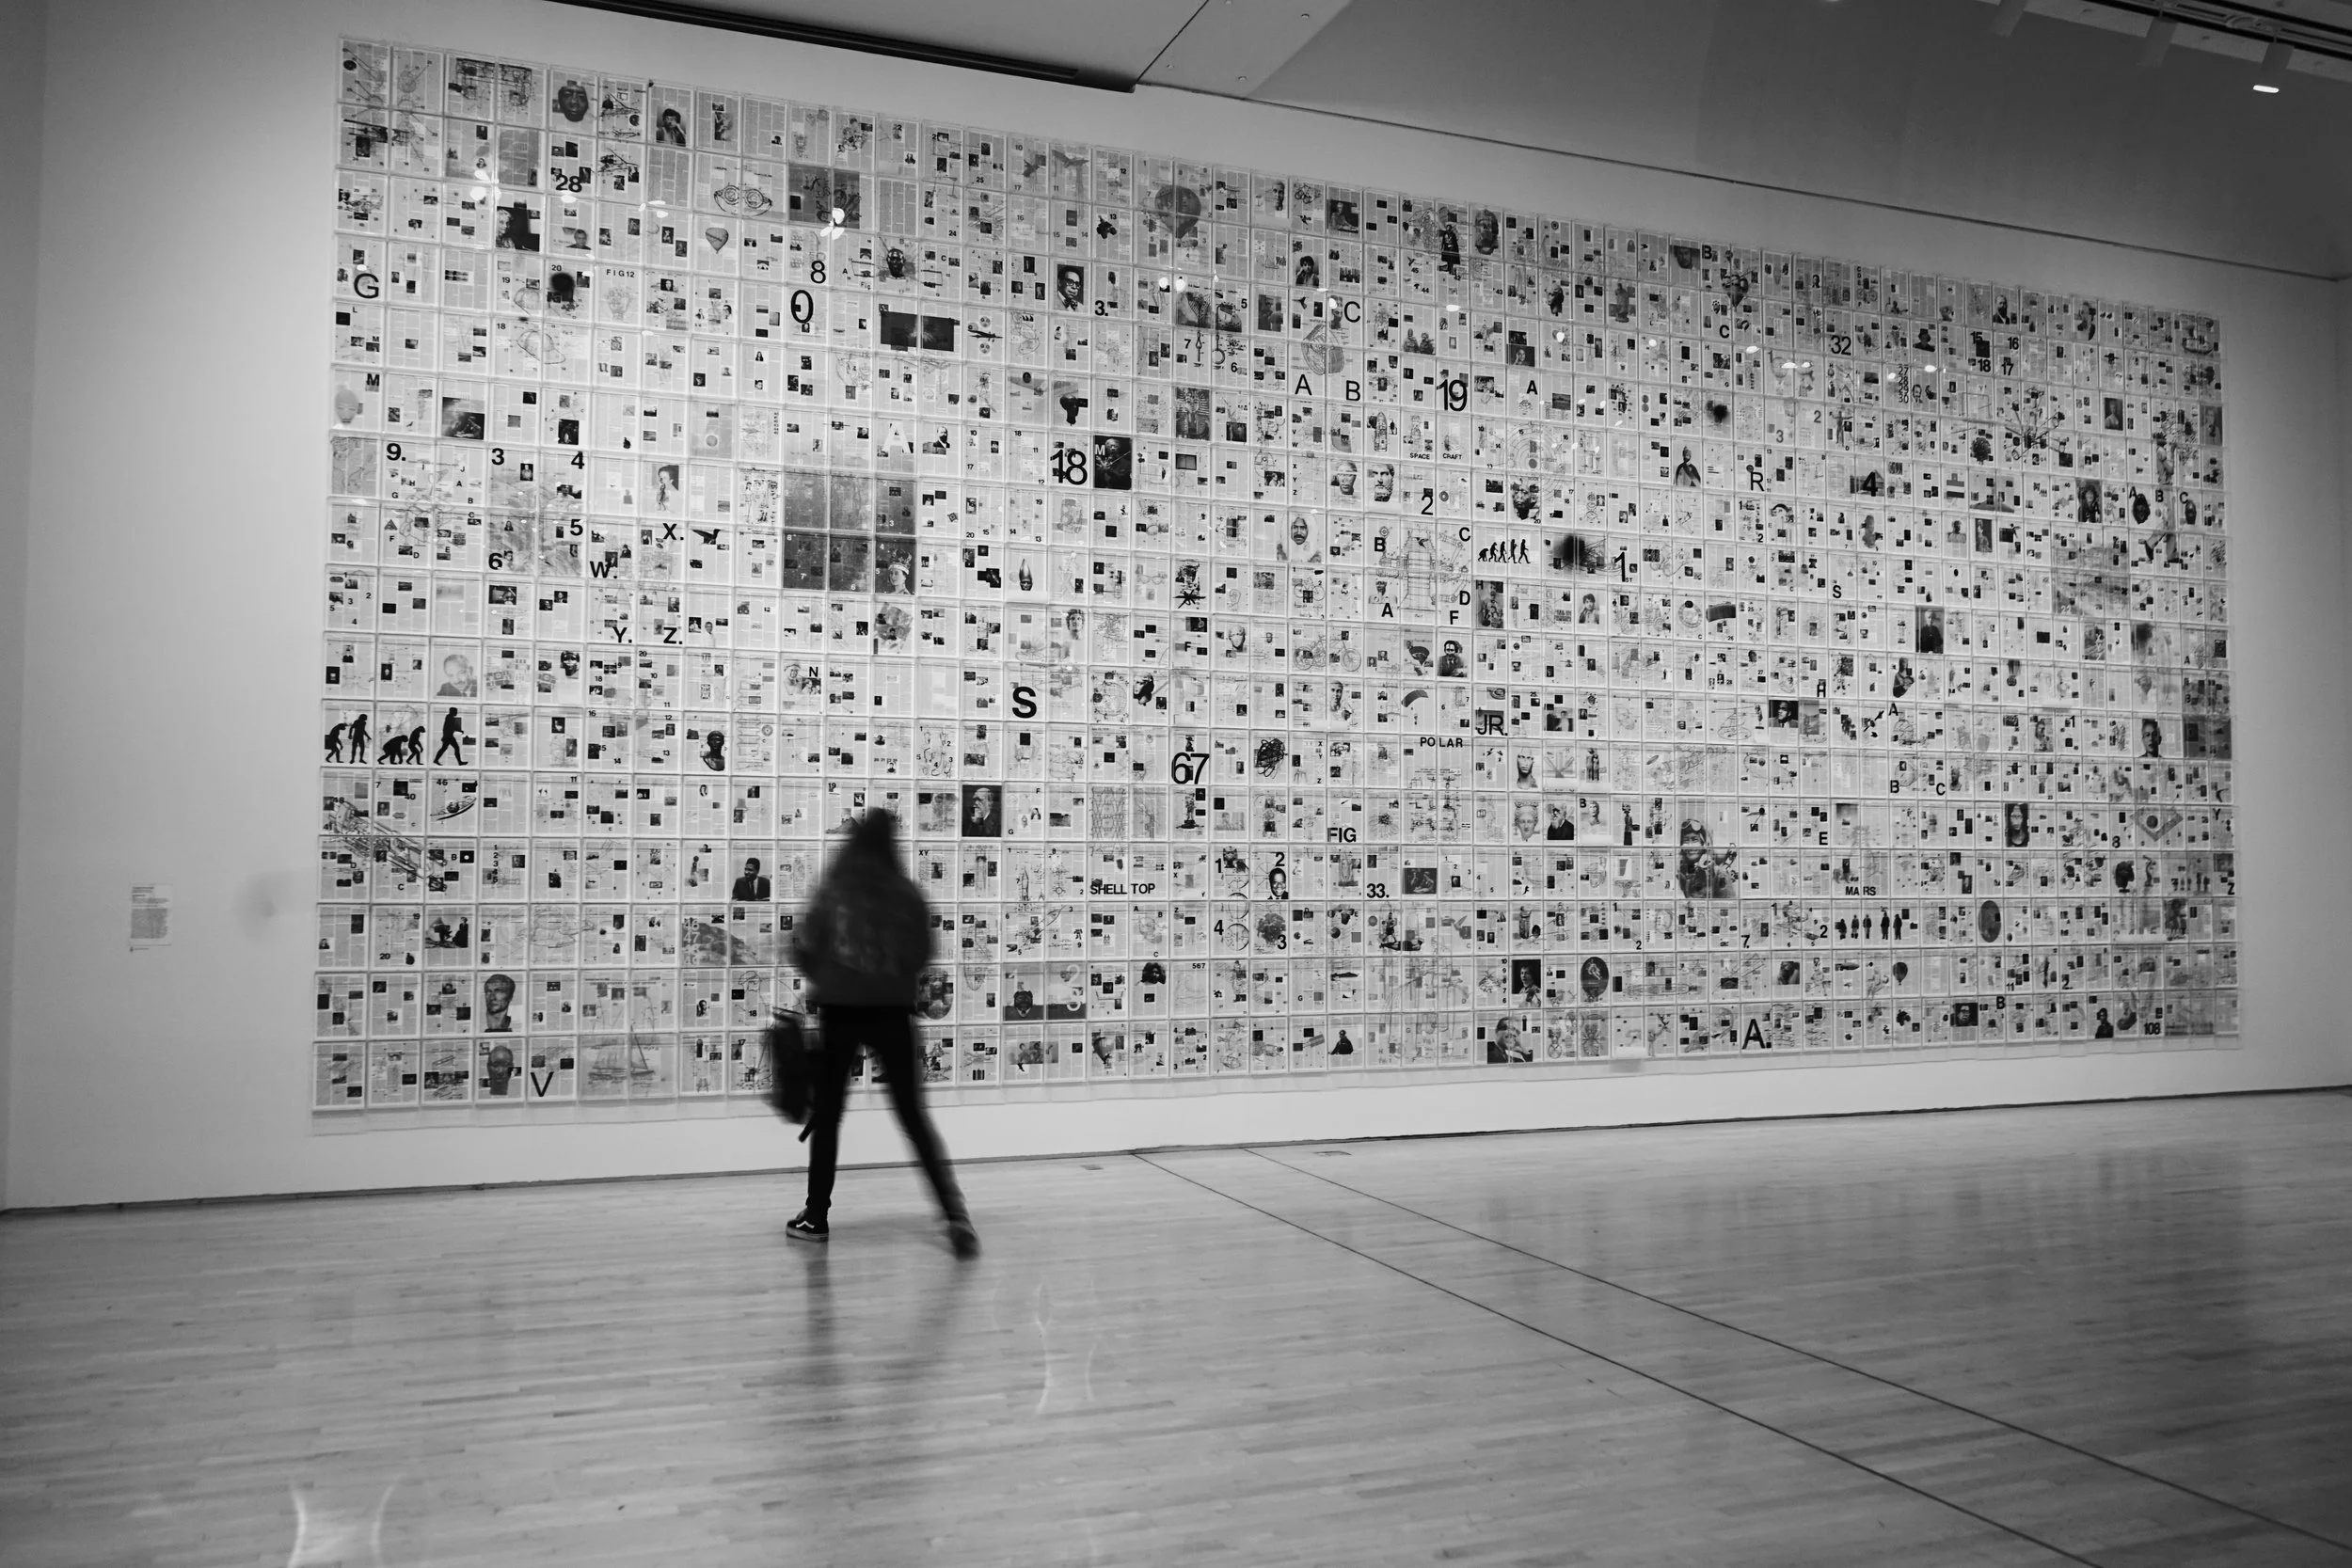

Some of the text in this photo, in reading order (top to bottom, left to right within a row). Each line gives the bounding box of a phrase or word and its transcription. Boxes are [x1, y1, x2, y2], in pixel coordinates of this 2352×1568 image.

[555, 173, 584, 193] 28
[1702, 245, 1712, 260] B
[810, 260, 826, 284] 8
[354, 273, 379, 299] G
[1241, 298, 1248, 309] 5
[1344, 301, 1360, 323] C
[1719, 325, 1729, 339] C
[1184, 339, 1191, 349] 7
[1831, 335, 1851, 356] 32
[2008, 337, 2019, 350] 16
[1231, 362, 1238, 372] 6
[1899, 364, 1909, 377] 27
[1978, 358, 1991, 372] 18
[366, 373, 380, 387] M
[1295, 374, 1312, 396] A
[1526, 380, 1538, 395] A
[1898, 374, 1909, 387] 28
[1346, 380, 1360, 402] B
[1436, 379, 1468, 412] 19
[1899, 392, 1909, 404] 30
[1814, 410, 1821, 423] 2
[492, 448, 504, 466] 3
[1094, 444, 1105, 455] M
[571, 451, 585, 469] 4
[1050, 448, 1088, 485] 18
[1749, 470, 1764, 492] R
[2128, 486, 2138, 500] A
[2155, 489, 2164, 502] B
[1421, 494, 1433, 515] 2
[570, 518, 583, 536] 5
[1459, 527, 1470, 542] C
[1375, 537, 1386, 552] B
[488, 552, 503, 570] 6
[1459, 590, 1470, 606] D
[1833, 585, 1841, 598] S
[1381, 603, 1393, 618] A
[1450, 610, 1459, 625] F
[1184, 641, 1192, 652] F
[809, 666, 818, 677] N
[1012, 685, 1037, 719] S
[1888, 703, 1899, 716] A
[1171, 752, 1210, 784] 67
[1890, 780, 1899, 793] B
[1936, 783, 1946, 796] C
[1580, 799, 1587, 808] B
[2213, 808, 2221, 820] Y
[1327, 827, 1356, 843] FIG
[1819, 832, 1828, 846] E
[1215, 858, 1221, 873] 1
[1274, 851, 1285, 867] 2
[1090, 882, 1155, 895] SHELL TOP
[2227, 881, 2234, 895] Z
[1214, 919, 1224, 936] 4
[1820, 925, 1828, 938] 2
[1276, 933, 1287, 950] 3
[1636, 940, 1642, 950] 2
[1996, 995, 2006, 1009] B
[2144, 1022, 2161, 1035] 108
[530, 1071, 554, 1097] V
